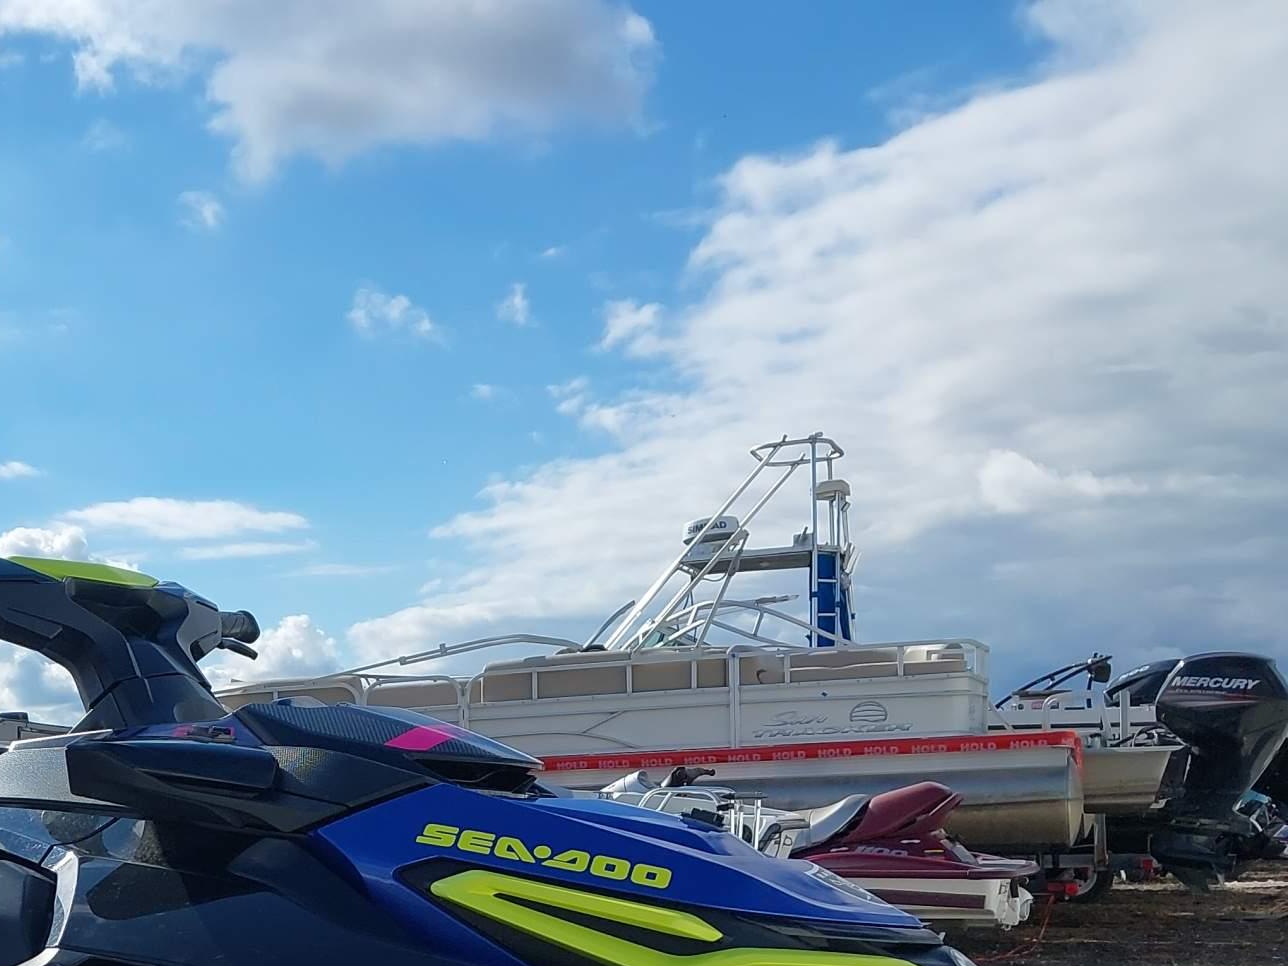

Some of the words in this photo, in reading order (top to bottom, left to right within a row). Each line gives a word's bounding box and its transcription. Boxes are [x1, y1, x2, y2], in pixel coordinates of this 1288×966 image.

[688, 520, 727, 534] SIMAD
[1172, 676, 1261, 690] MERCURY
[557, 760, 588, 770] HOLD
[598, 759, 630, 769] HOLD
[641, 758, 673, 767] HOLD
[684, 756, 717, 765] HOLD
[728, 753, 761, 763] HOLD
[772, 750, 806, 760] HOLD
[818, 748, 852, 758] HOLD
[864, 746, 899, 756] HOLD
[912, 744, 947, 753] HOLD
[960, 742, 997, 752] HOLD
